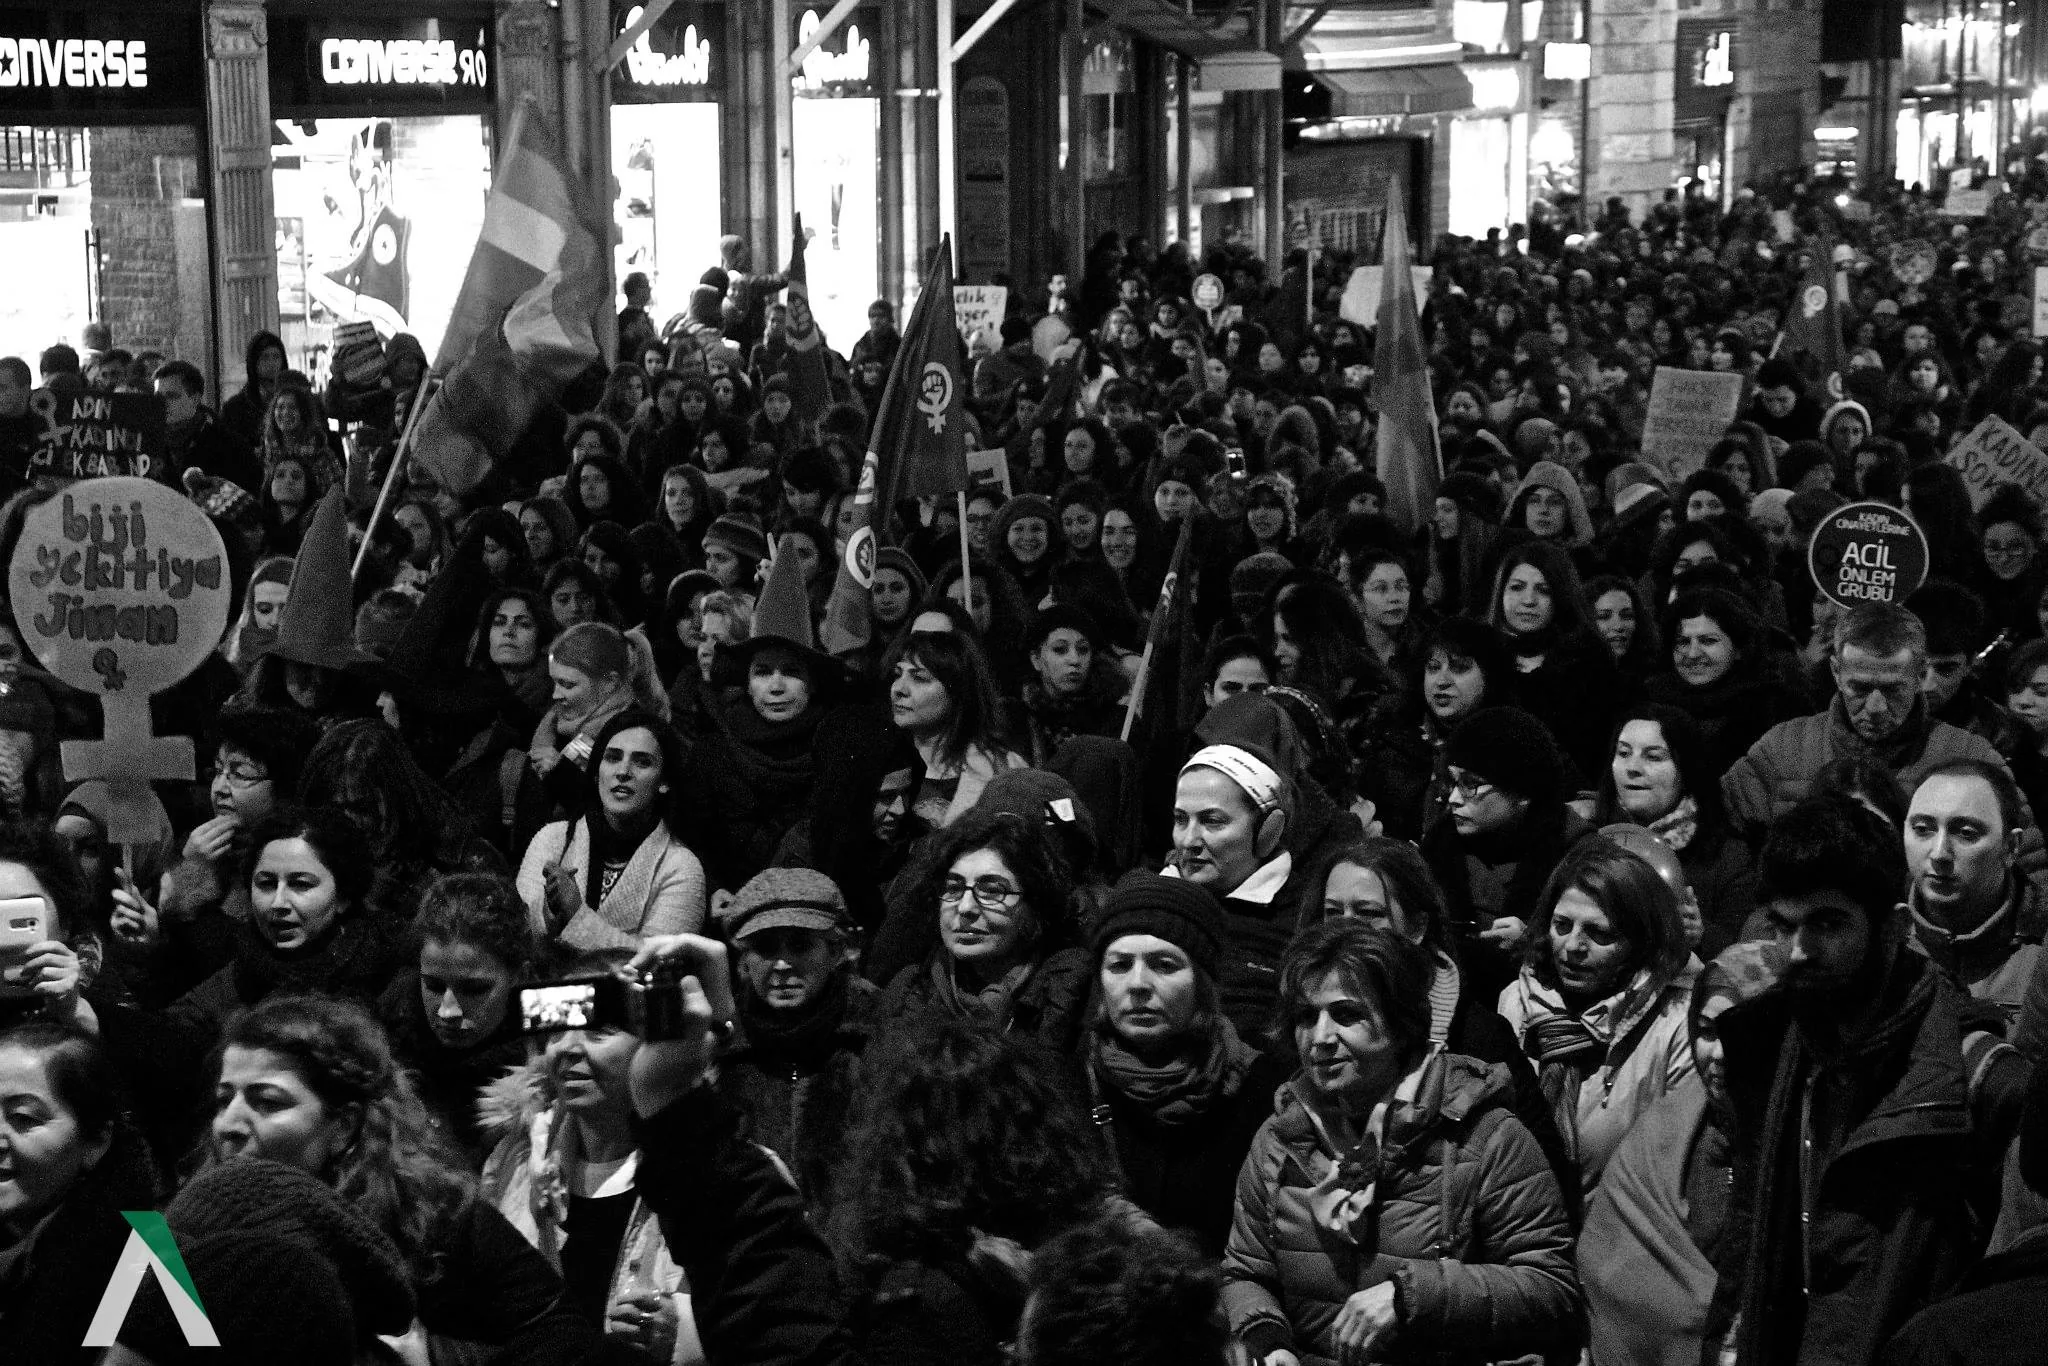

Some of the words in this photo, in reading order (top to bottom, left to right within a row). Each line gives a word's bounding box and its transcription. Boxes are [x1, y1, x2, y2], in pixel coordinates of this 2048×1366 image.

[322, 38, 458, 85] CONVERSE
[1841, 539, 1897, 570] ACİL
[1838, 564, 1896, 587] ÖNLEM
[1836, 582, 1894, 602] GRUBU
